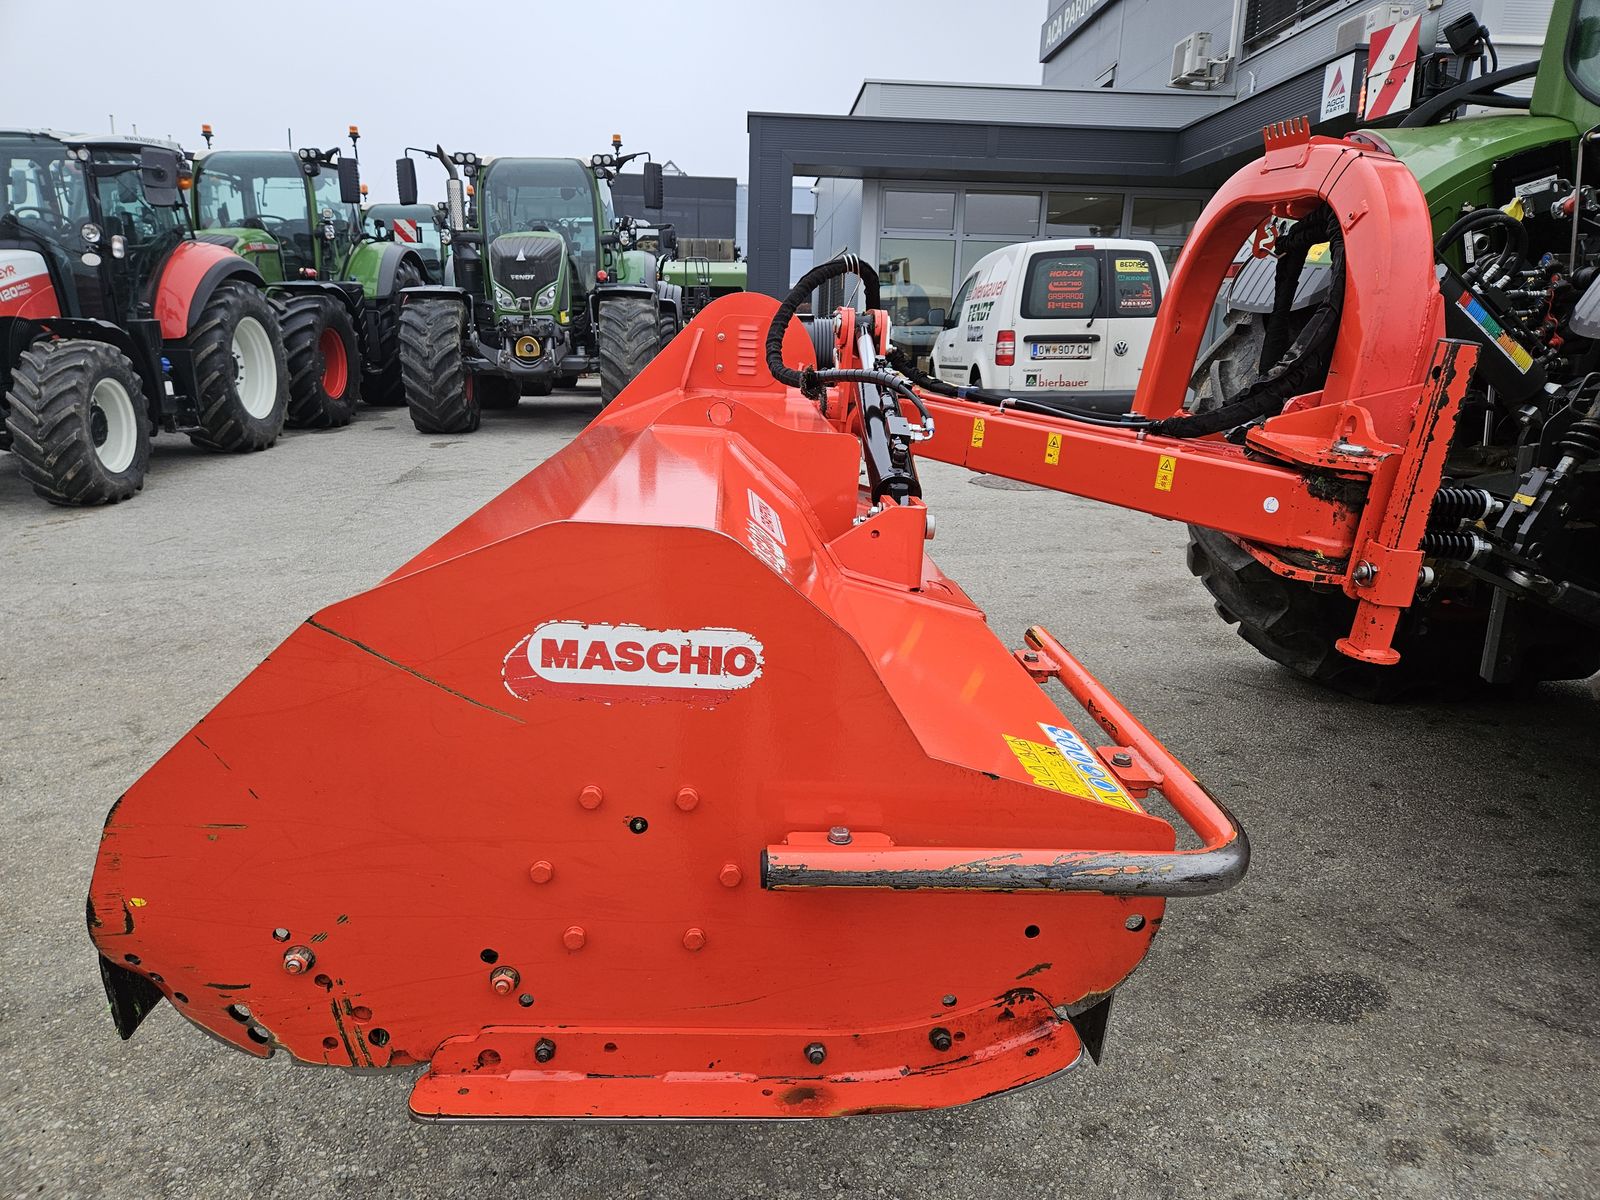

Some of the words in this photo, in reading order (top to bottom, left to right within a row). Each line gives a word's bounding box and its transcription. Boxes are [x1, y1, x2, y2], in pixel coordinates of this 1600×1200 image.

[1045, 14, 1063, 49] ACA
[1326, 95, 1346, 108] AGCO
[1325, 103, 1345, 114] PARTS
[1058, 345, 1076, 355] 907
[1077, 345, 1090, 355] CM
[1038, 374, 1089, 387] bierbauer
[540, 637, 758, 677] MASCHIO
